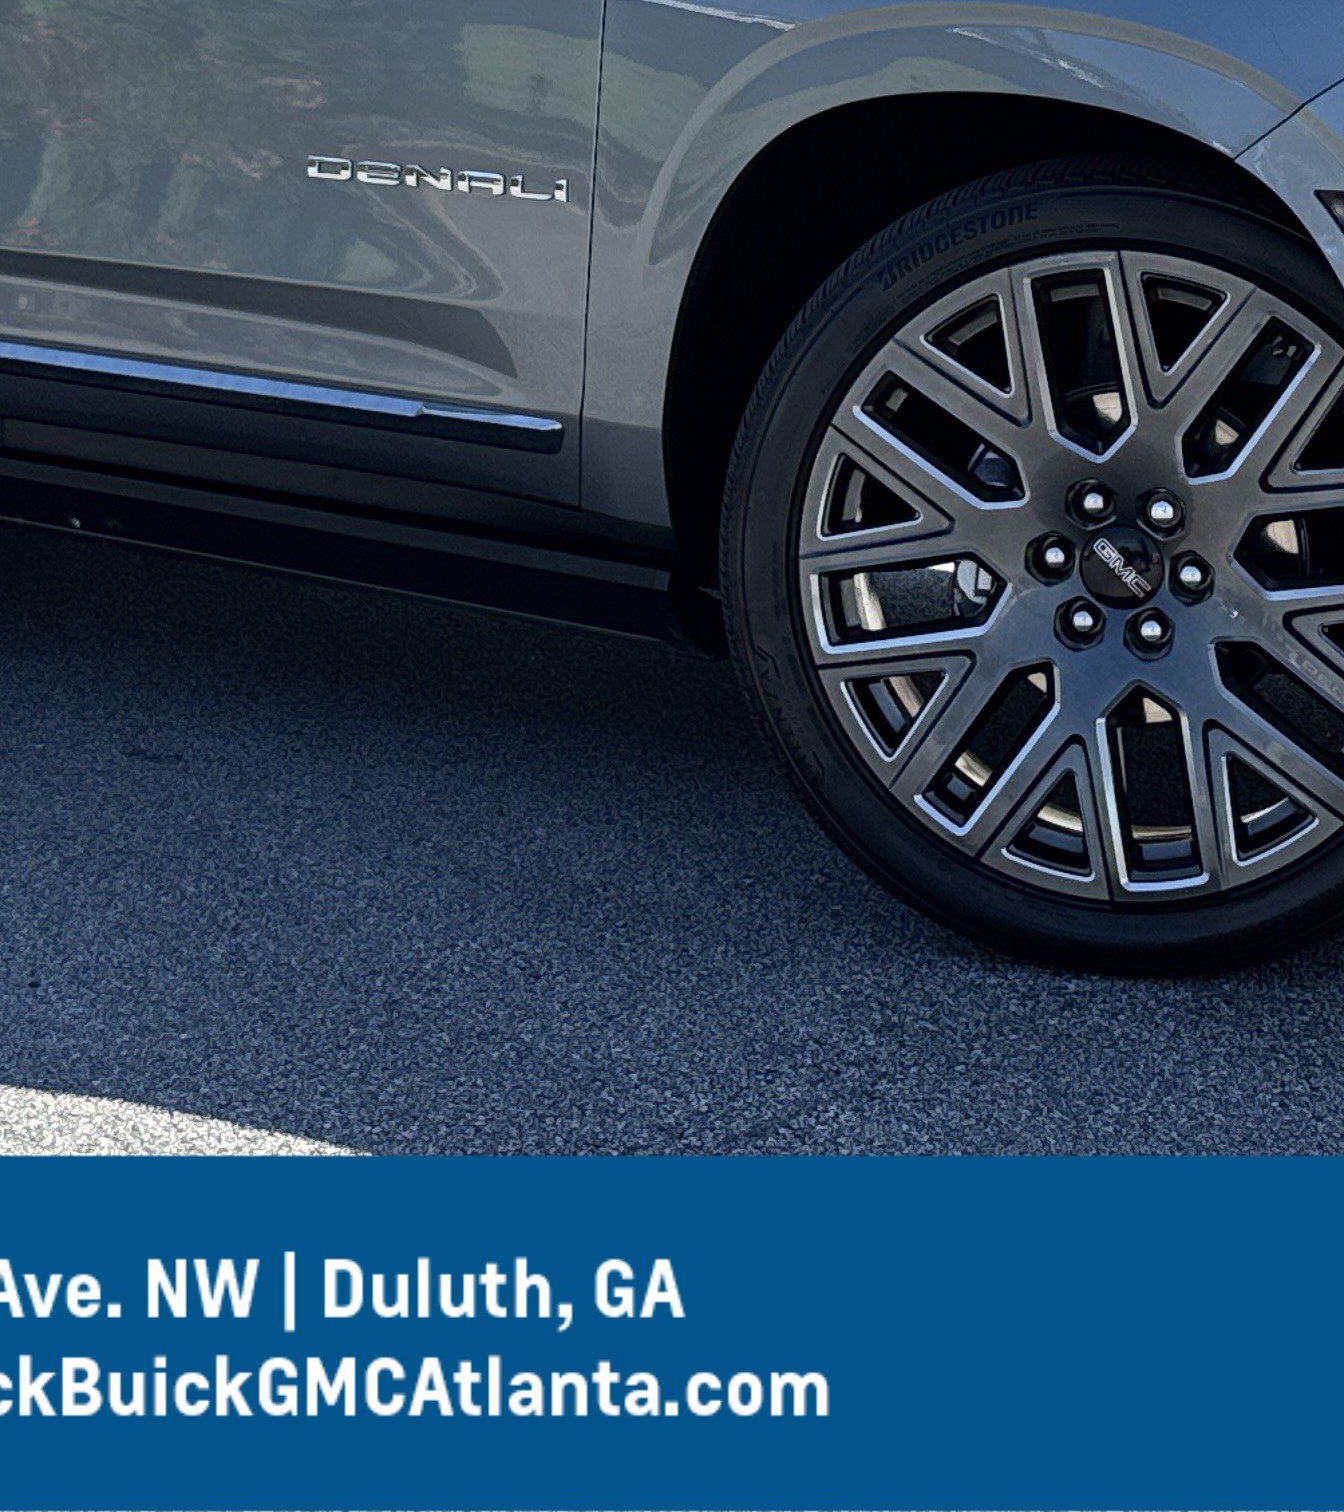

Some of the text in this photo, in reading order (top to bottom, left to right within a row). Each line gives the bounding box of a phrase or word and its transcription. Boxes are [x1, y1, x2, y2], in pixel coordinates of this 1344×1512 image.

[306, 154, 570, 204] DENALI
[876, 199, 1039, 292] BRIDGESTONE
[1093, 537, 1152, 598] GMC
